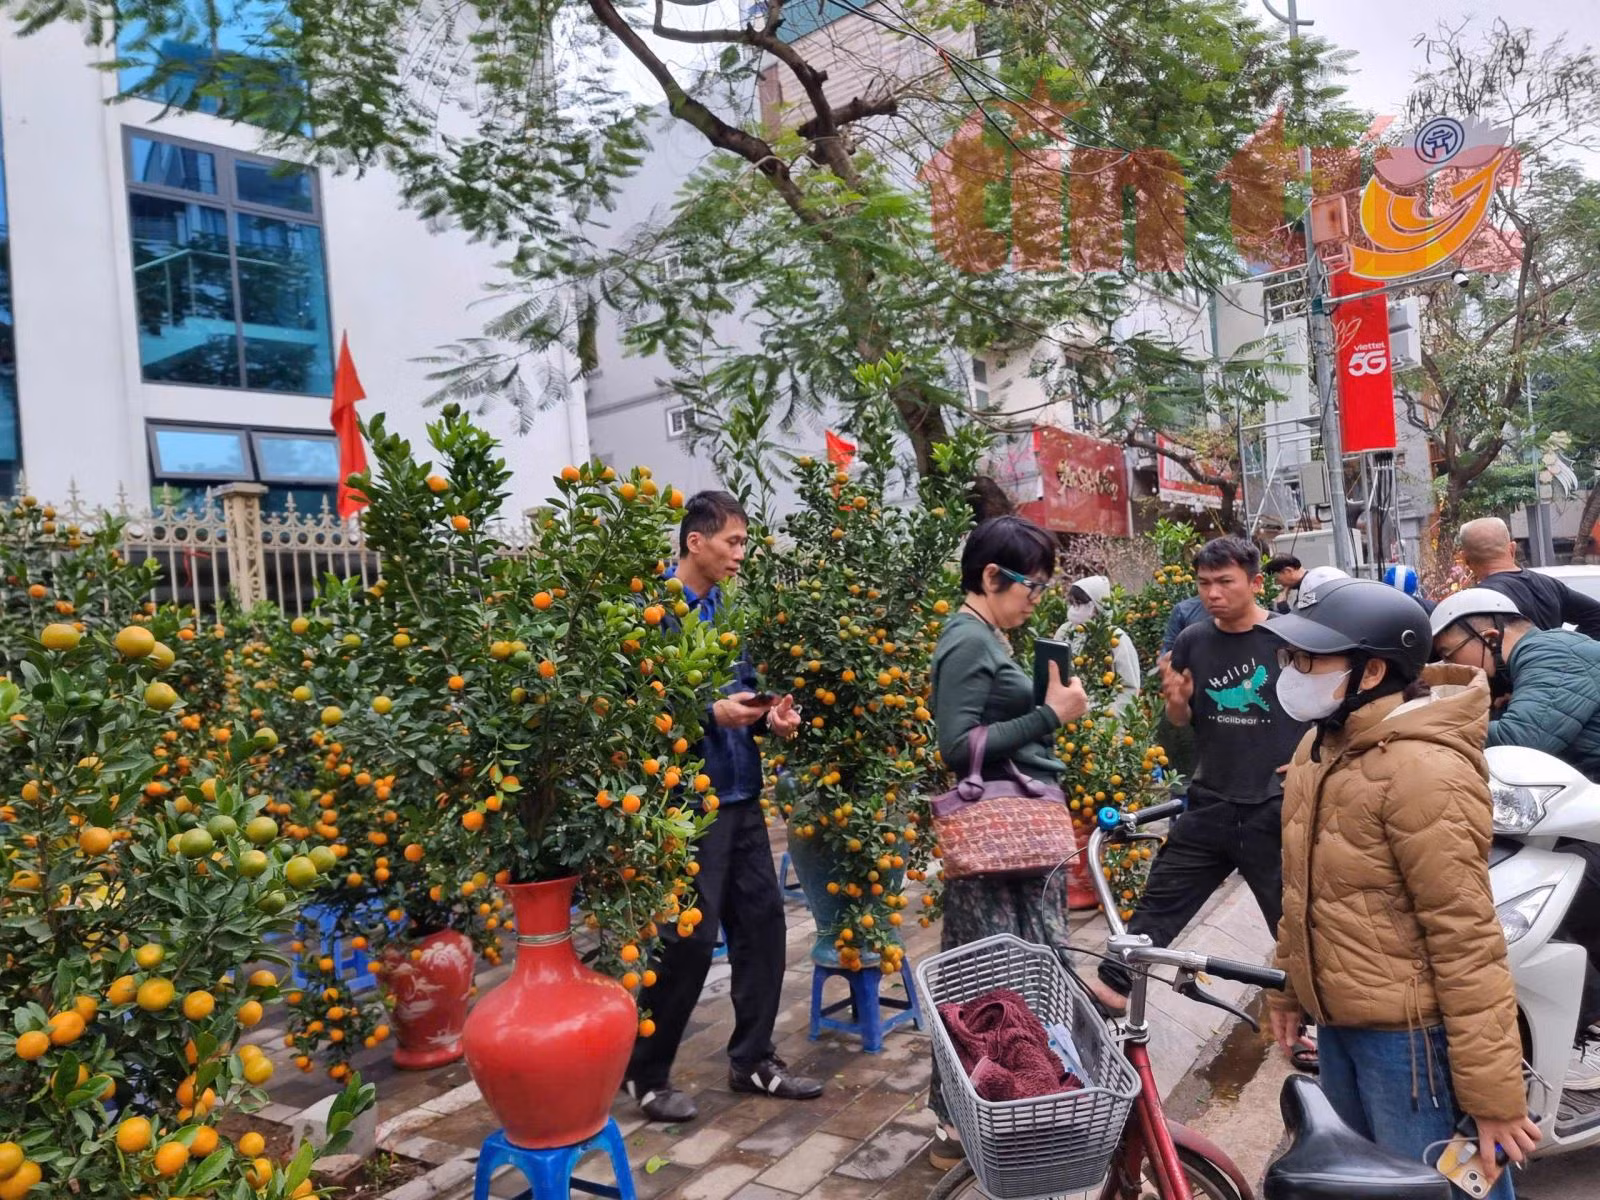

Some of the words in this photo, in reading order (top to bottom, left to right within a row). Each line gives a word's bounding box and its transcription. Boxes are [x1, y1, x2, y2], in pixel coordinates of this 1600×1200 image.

[1354, 341, 1386, 351] viettel
[1348, 350, 1387, 376] 5G
[1208, 657, 1256, 688] Hello!
